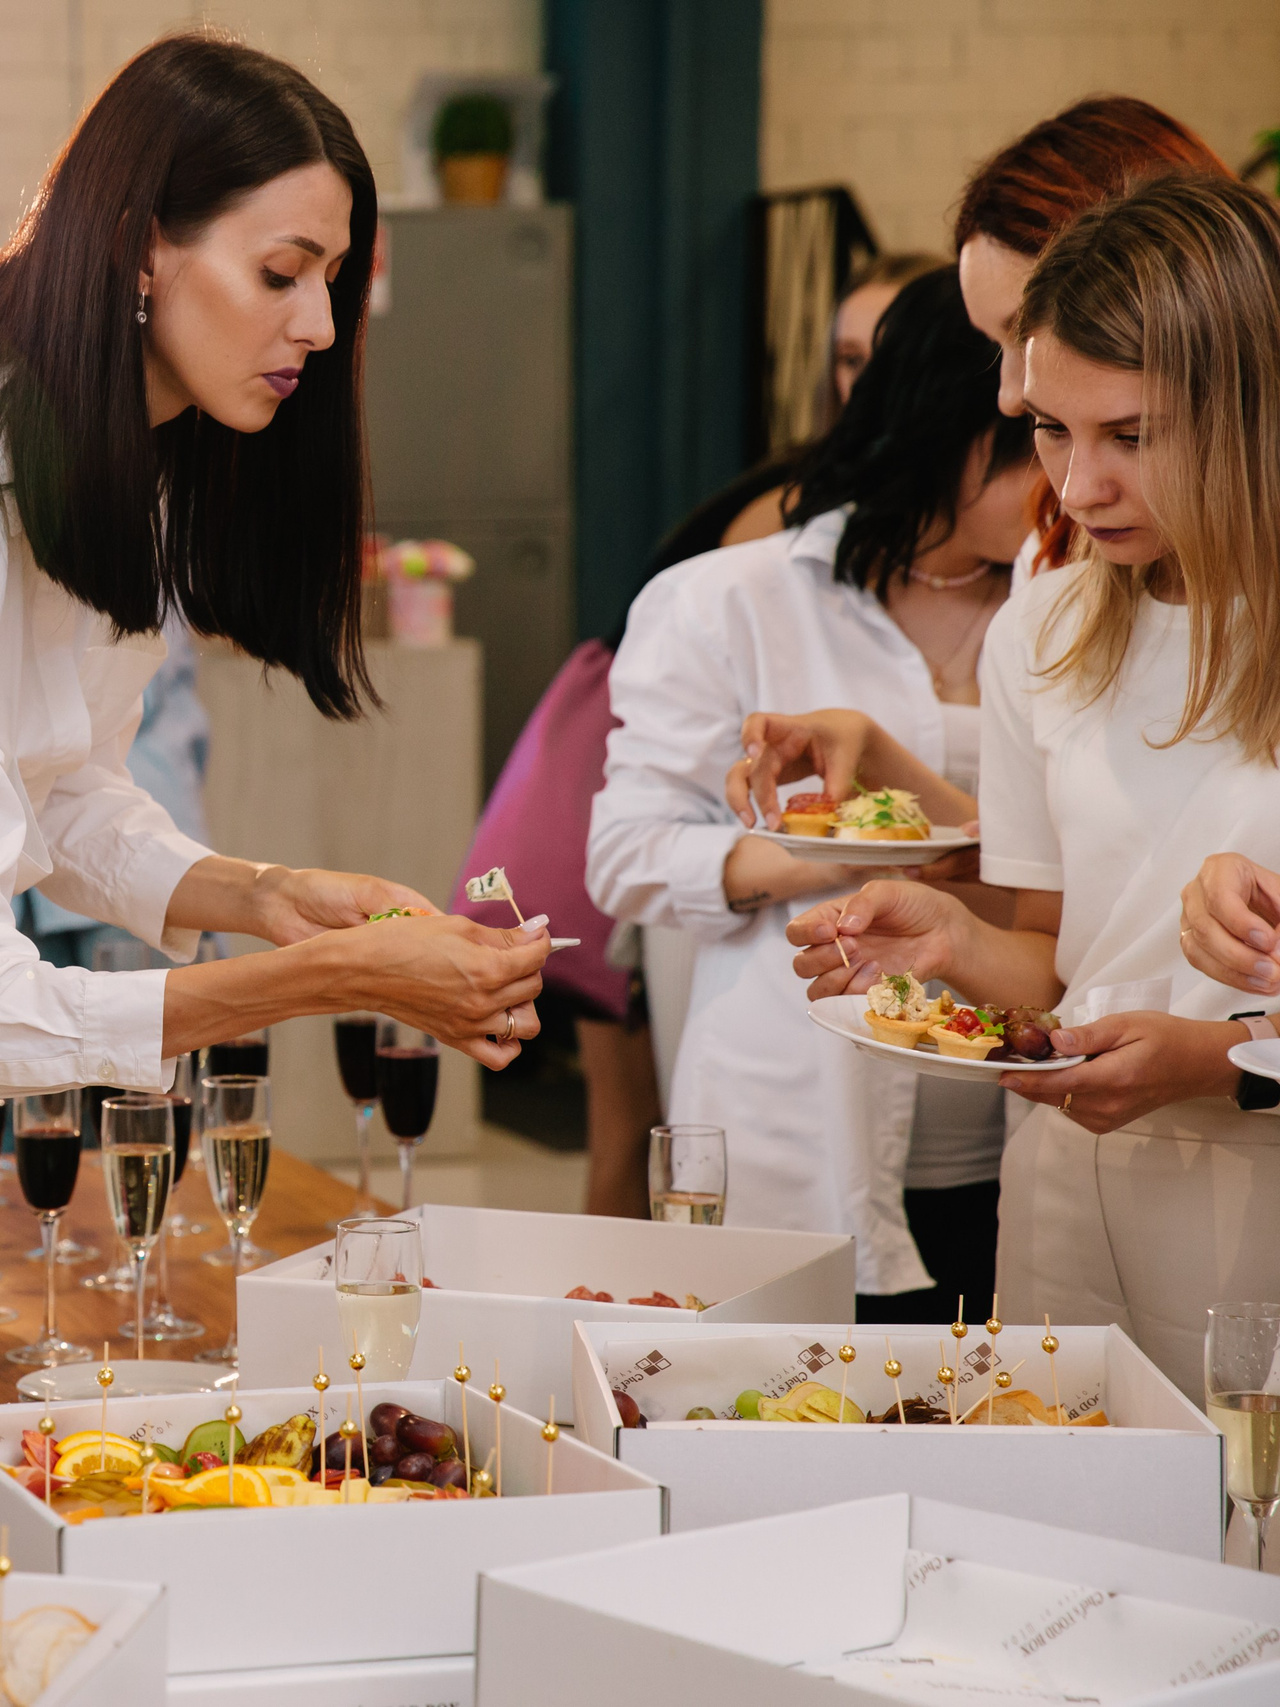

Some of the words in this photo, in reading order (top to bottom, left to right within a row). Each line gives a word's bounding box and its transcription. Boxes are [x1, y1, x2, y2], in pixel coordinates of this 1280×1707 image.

[613, 1373, 645, 1393] Chef's
[778, 1371, 809, 1393] Chef's
[1045, 1611, 1077, 1640] FOOD
[1020, 1632, 1047, 1657] BOX
